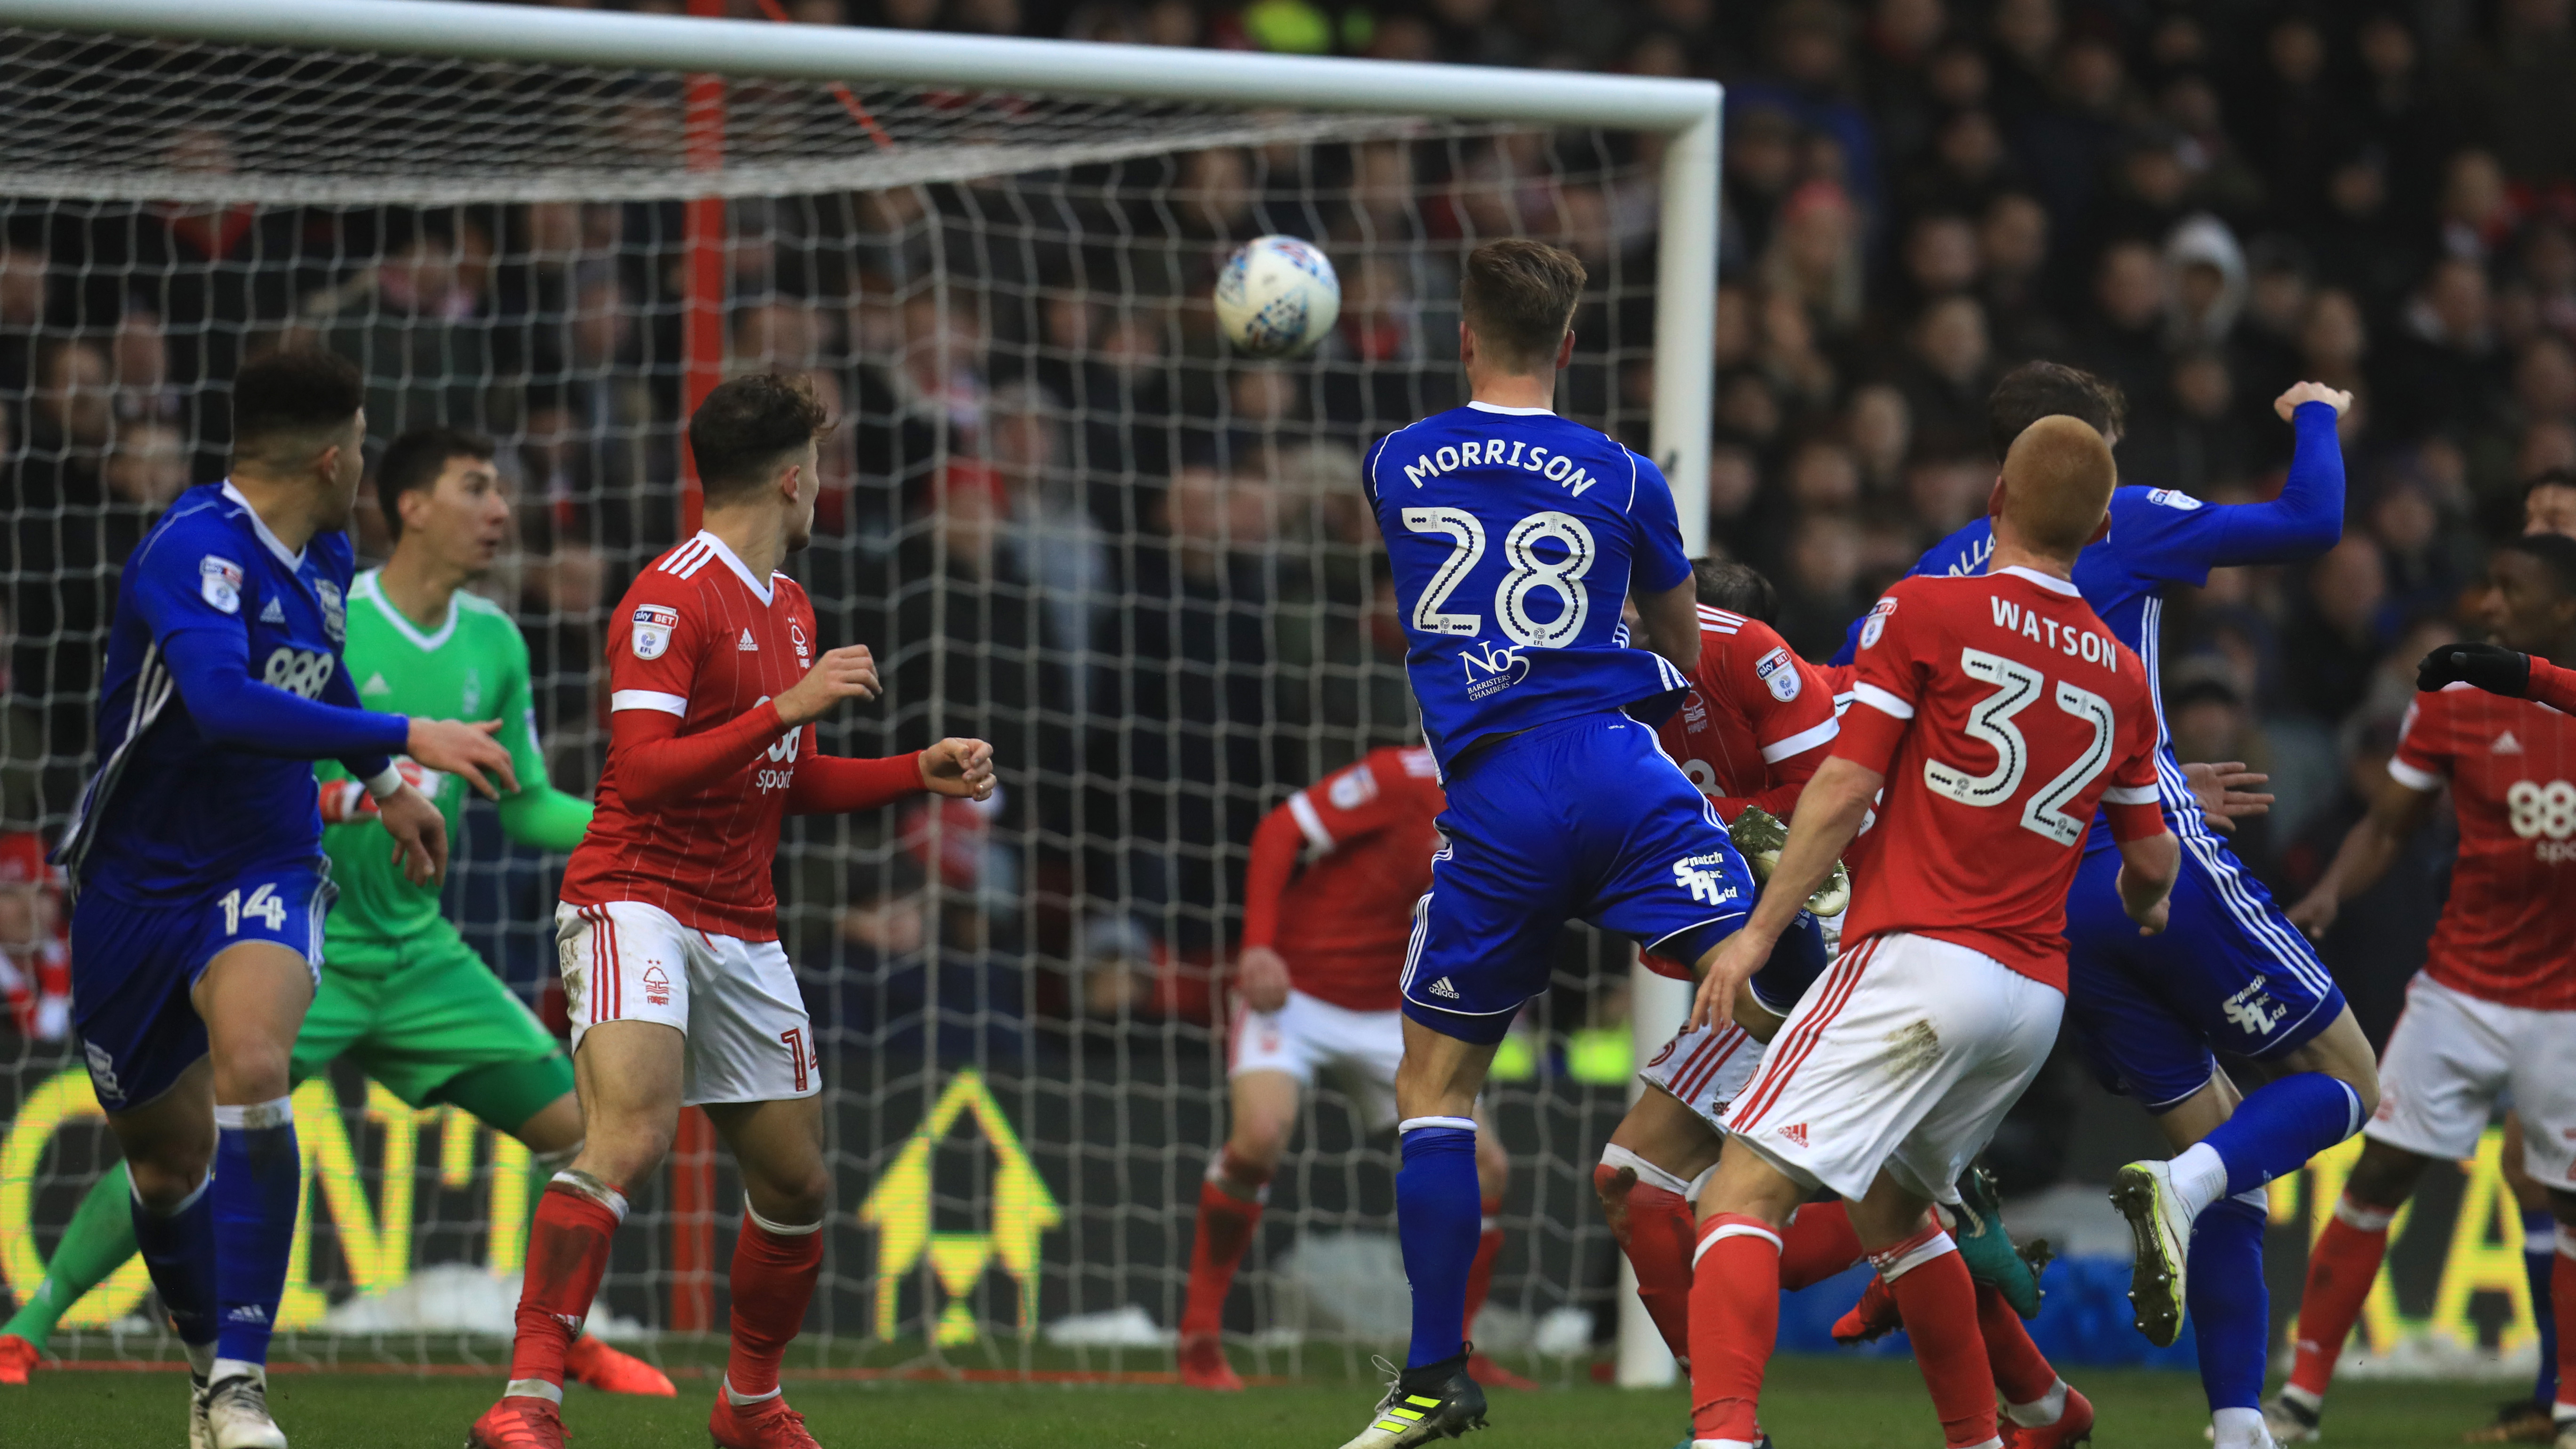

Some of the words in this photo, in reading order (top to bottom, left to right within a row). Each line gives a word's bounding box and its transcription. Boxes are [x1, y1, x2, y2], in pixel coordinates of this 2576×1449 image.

[1403, 439, 1596, 497] MORRISON
[1401, 507, 1595, 649] 28
[635, 611, 652, 621] sky
[655, 614, 675, 625] BET
[1990, 595, 2117, 673] WATSON
[1774, 652, 1788, 665] BET
[1467, 673, 1511, 694] BARRISTERS
[1469, 681, 1510, 701] CHAMBERS
[1923, 647, 2114, 847] 32
[756, 766, 794, 795] sport
[217, 882, 287, 937] 14
[1429, 986, 1460, 999] adidas
